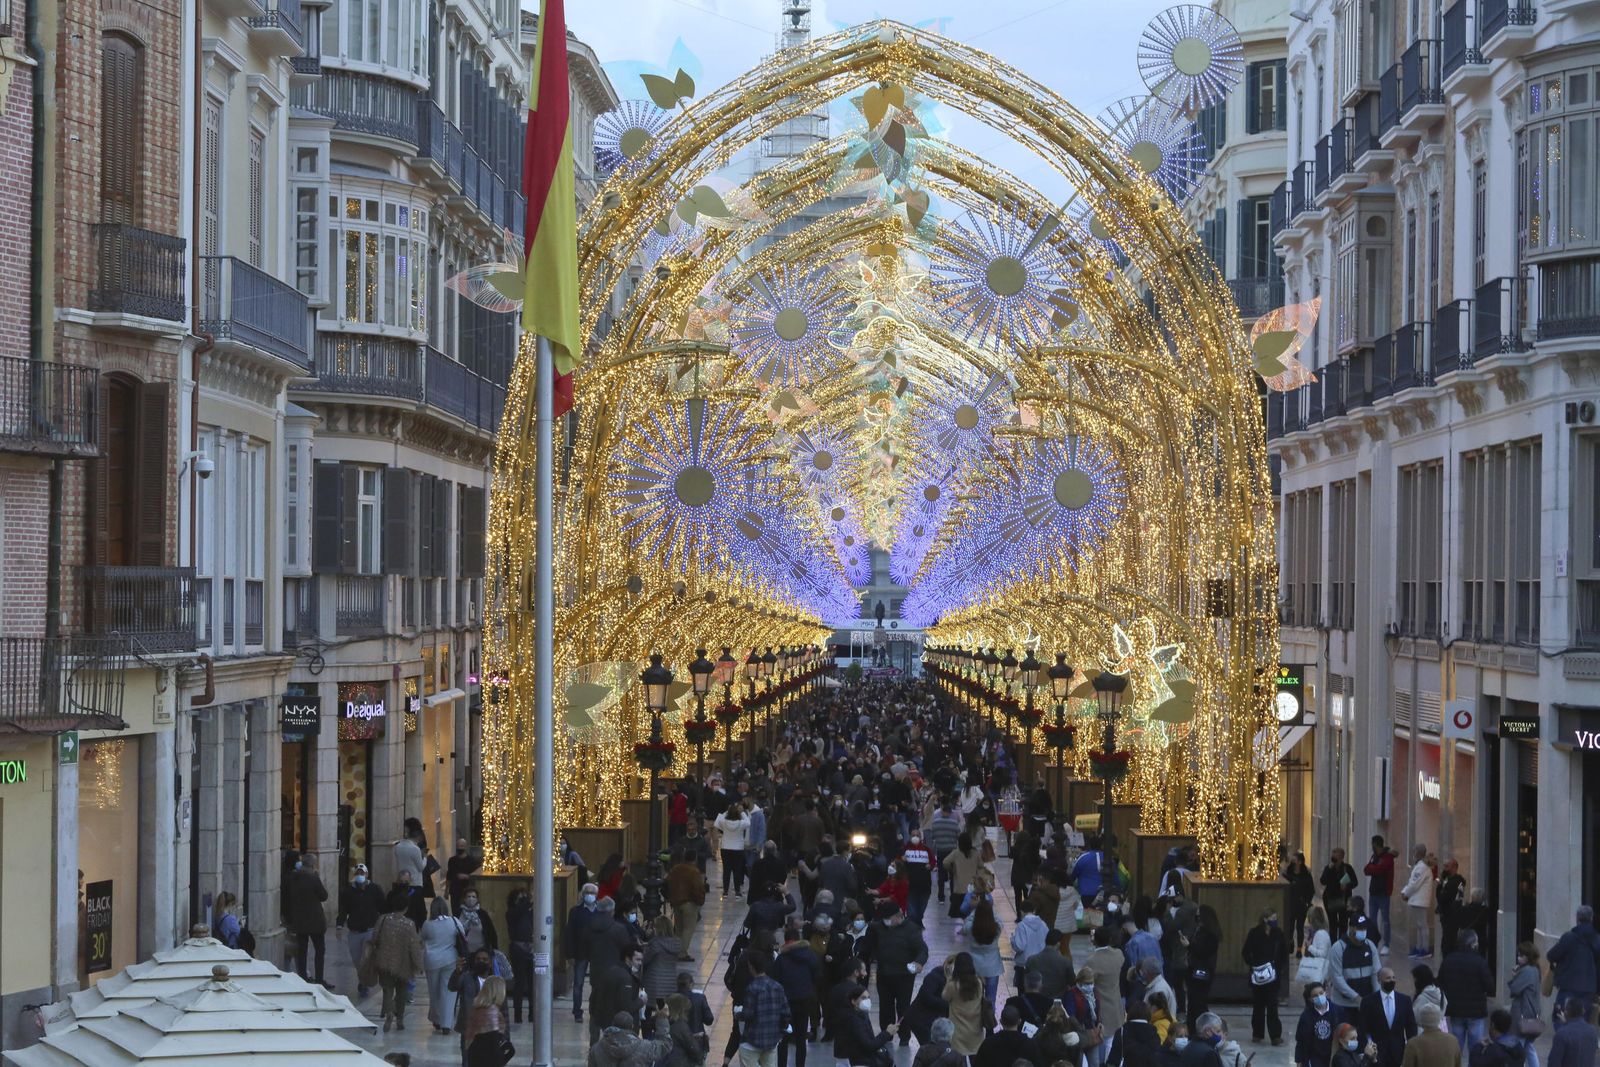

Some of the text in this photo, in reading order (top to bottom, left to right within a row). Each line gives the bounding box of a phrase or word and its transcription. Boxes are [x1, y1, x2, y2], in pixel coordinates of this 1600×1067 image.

[285, 705, 316, 715] NYX
[87, 896, 111, 913] BLACK
[87, 912, 111, 929] FRIDAY
